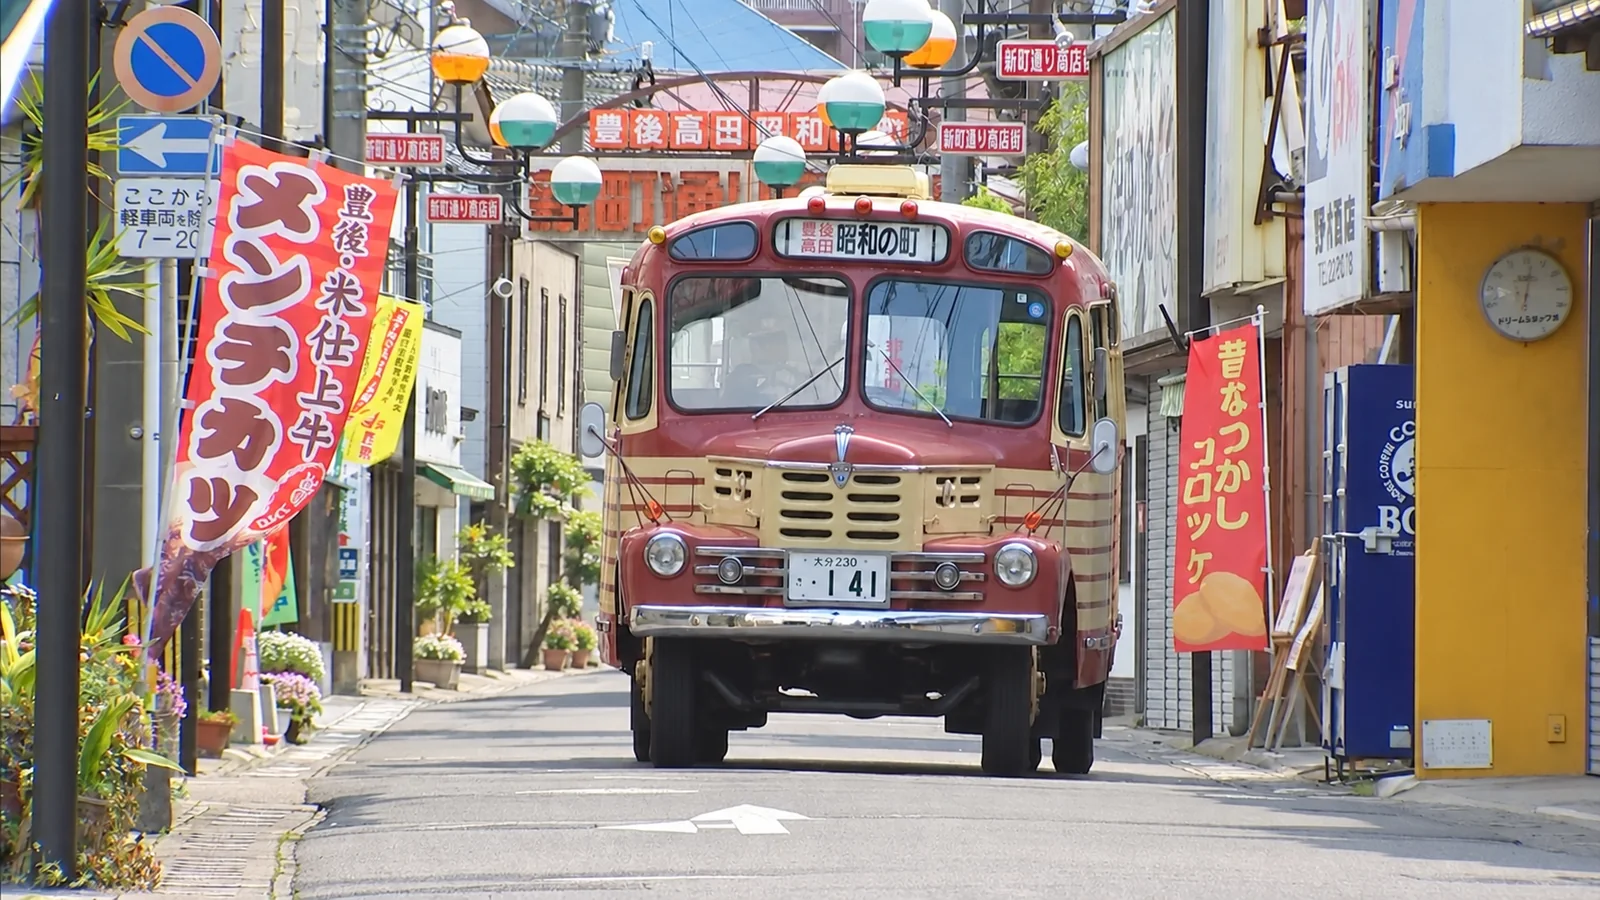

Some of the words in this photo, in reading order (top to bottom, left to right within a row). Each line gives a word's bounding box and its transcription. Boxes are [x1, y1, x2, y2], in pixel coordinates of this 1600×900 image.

[594, 112, 905, 147] 豊後高田昭和
[943, 128, 1021, 151] 新町通り商店街
[366, 139, 440, 161] 新町通り商店街
[125, 188, 212, 206] ここから
[430, 198, 498, 219] 新町通り商店街
[801, 222, 833, 237] 豊後
[837, 223, 920, 257] 昭和の町
[801, 238, 833, 254] 高田
[290, 184, 374, 459] 豊後・米仕上牛
[185, 166, 320, 546] メンチカツ
[1213, 338, 1250, 530] 昔なつかし
[1183, 437, 1215, 585] コロッケ
